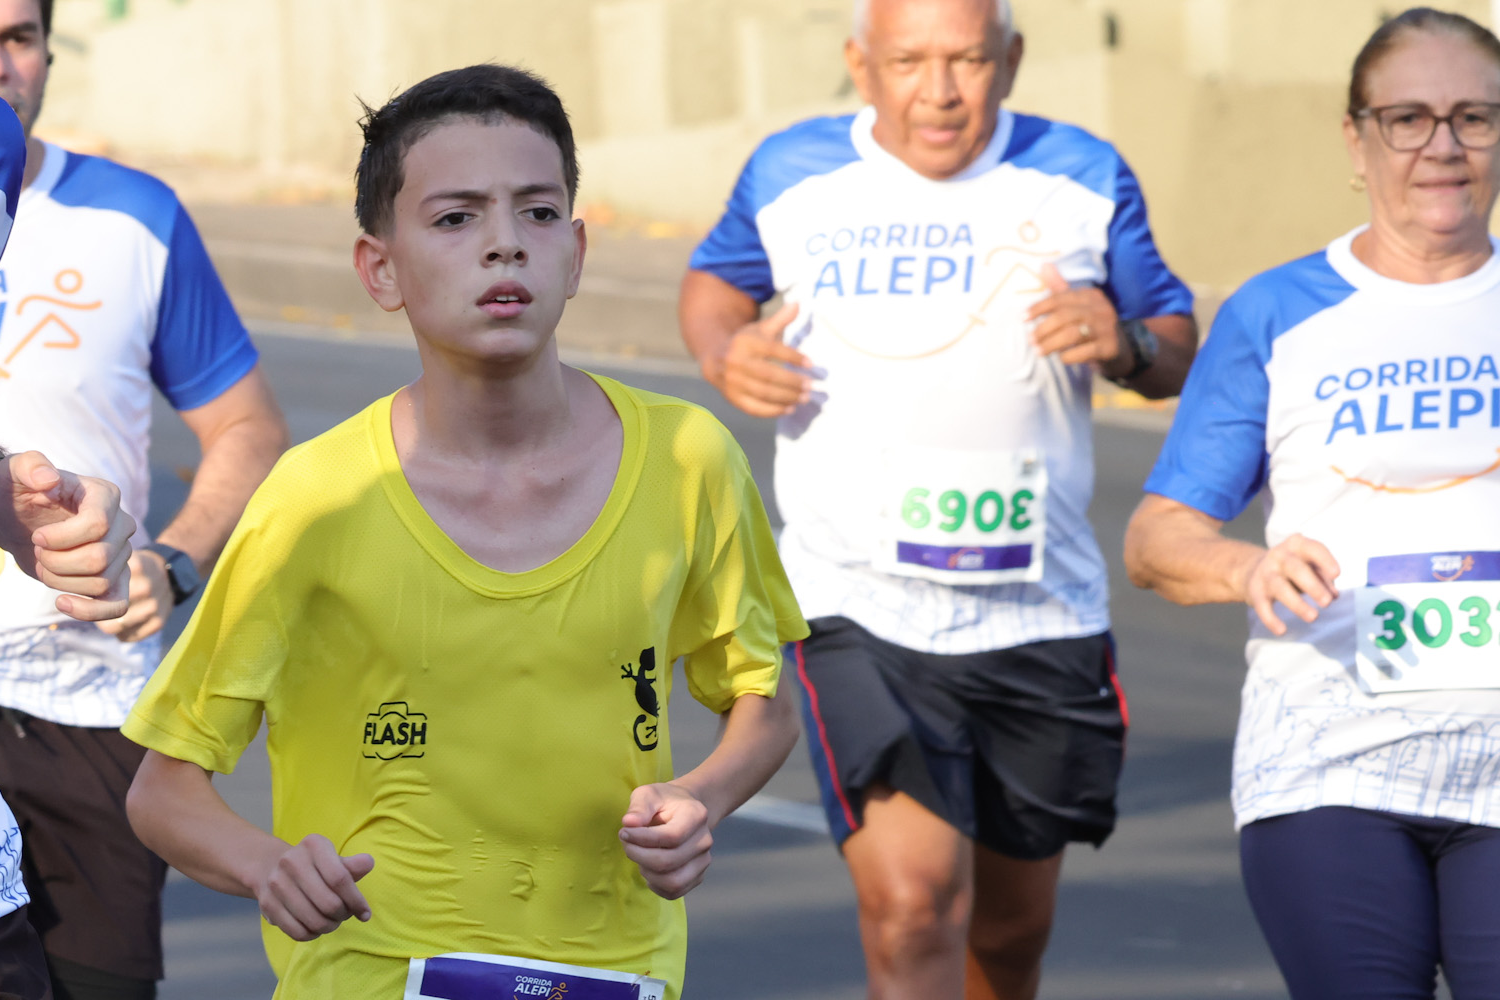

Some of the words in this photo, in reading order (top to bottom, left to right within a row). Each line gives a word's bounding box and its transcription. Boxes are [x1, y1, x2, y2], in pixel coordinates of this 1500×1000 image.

[806, 223, 974, 256] CORRIDA
[812, 255, 975, 298] ALEPI
[1314, 355, 1499, 400] CORRIDA
[1324, 388, 1500, 445] ALEPI
[1373, 595, 1500, 650] 303
[363, 722, 427, 745] FLASH
[513, 983, 551, 997] ALEPI
[515, 975, 553, 986] CORRIDA
